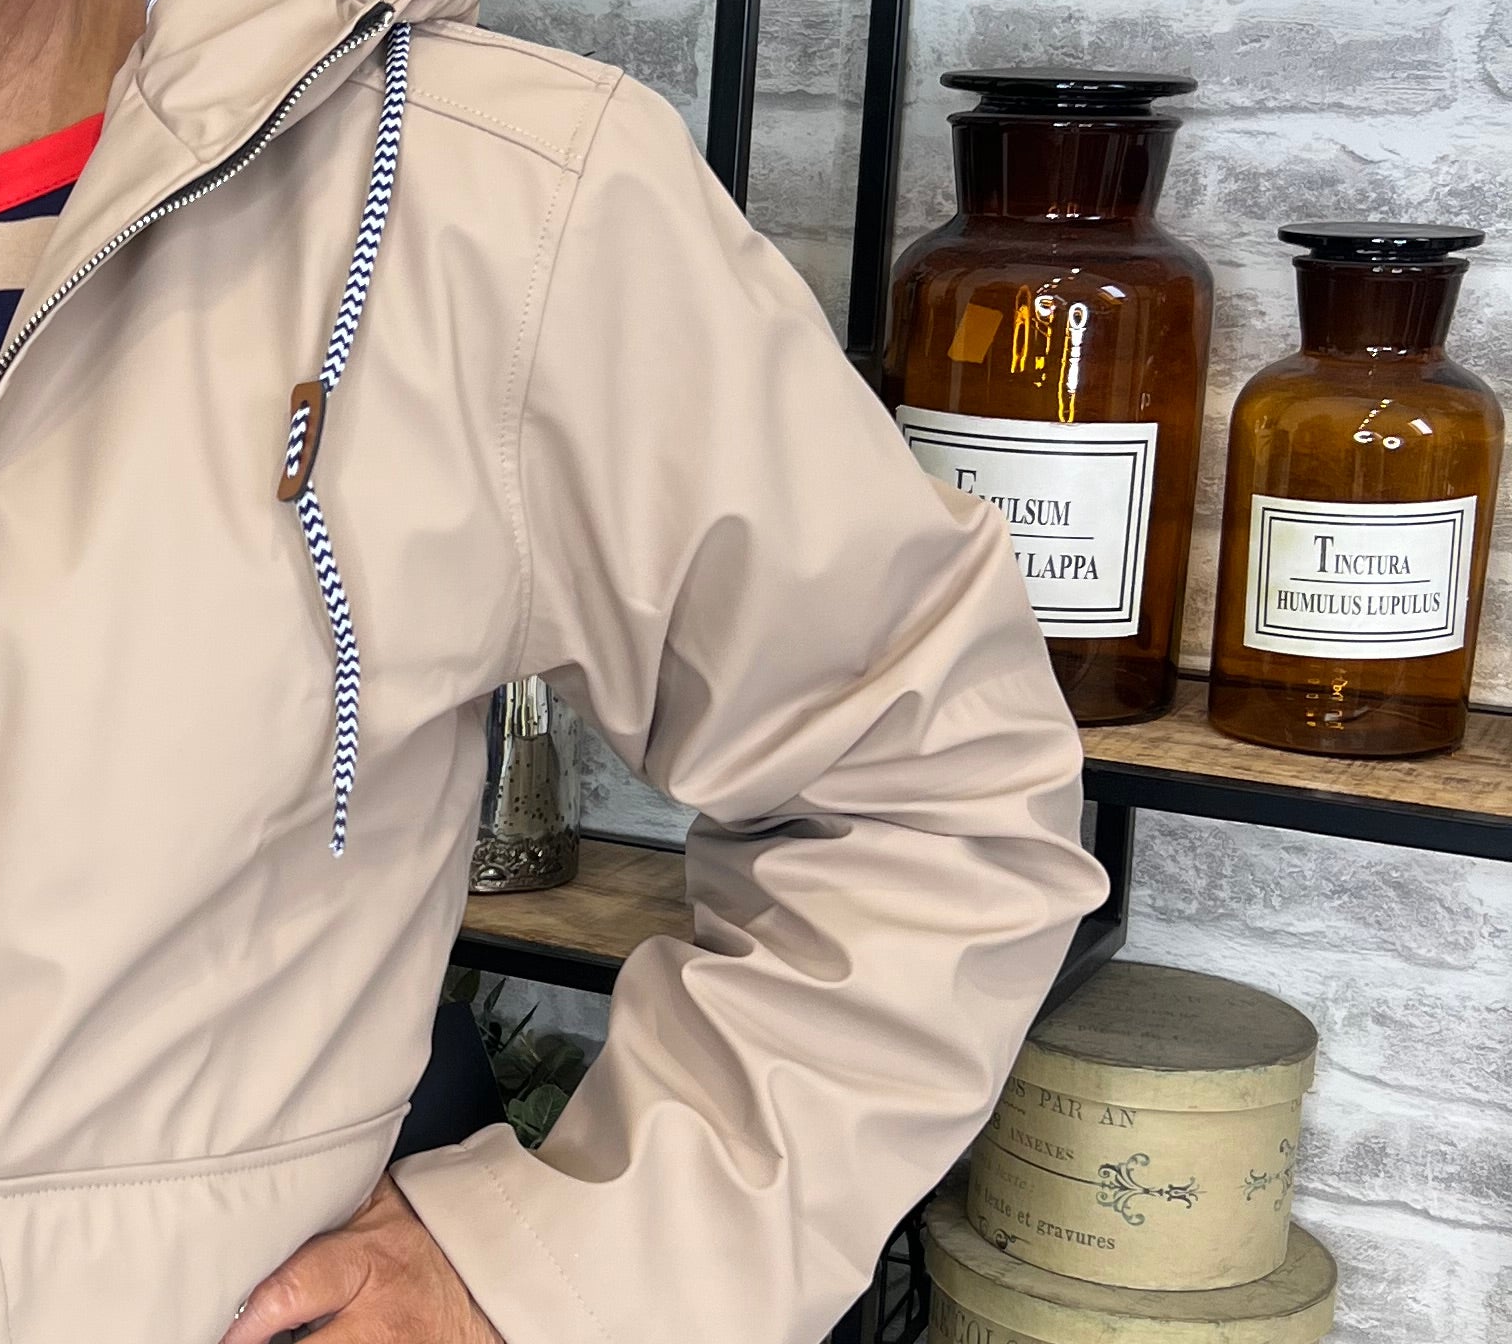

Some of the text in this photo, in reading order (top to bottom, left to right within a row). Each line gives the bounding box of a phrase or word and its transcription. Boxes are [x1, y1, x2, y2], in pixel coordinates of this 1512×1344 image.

[1026, 552, 1100, 580] LAPPA
[1313, 534, 1412, 576] TINCTURA
[1276, 589, 1441, 616] HUMULUS LUPULUS
[1038, 1088, 1084, 1121] PAR
[1098, 1106, 1137, 1129] AN
[1017, 1209, 1032, 1227] et
[1036, 1220, 1116, 1250] gravures
